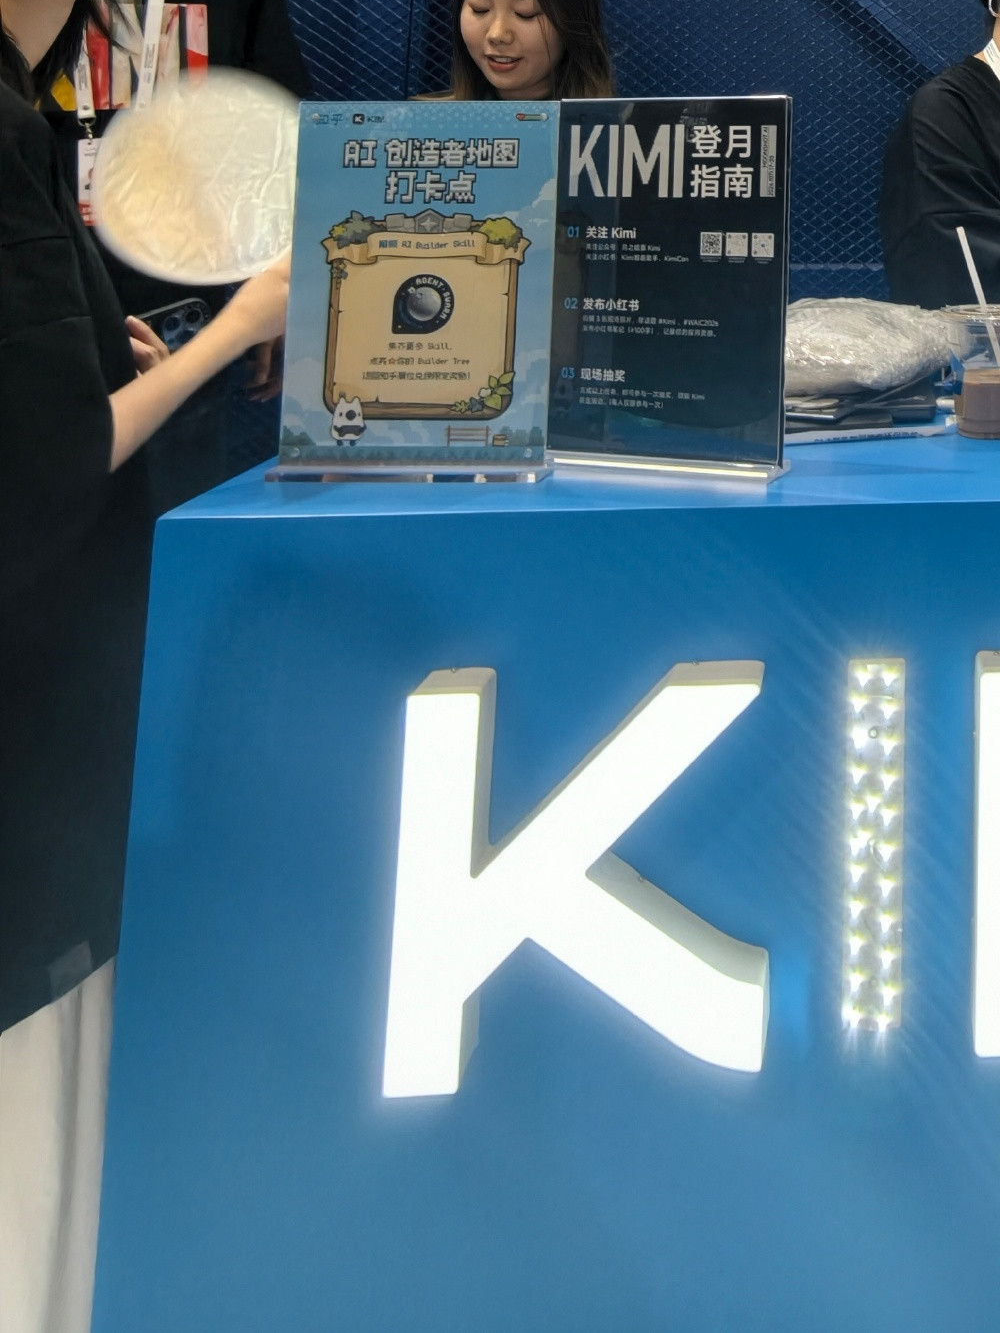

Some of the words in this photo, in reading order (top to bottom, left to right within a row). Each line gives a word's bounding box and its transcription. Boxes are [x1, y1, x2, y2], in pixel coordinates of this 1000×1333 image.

[691, 125, 752, 159] 登月
[343, 139, 378, 168] AI
[384, 138, 519, 168] 创造者地图
[568, 124, 685, 198] KIMI
[384, 171, 476, 204] 打卡点
[690, 164, 754, 199] 指南
[567, 226, 579, 238] 01
[586, 226, 609, 239] 关注
[611, 227, 637, 240] Kimi
[453, 239, 475, 249] Skill
[564, 297, 578, 310] 02
[583, 297, 640, 312] 发布小红书
[417, 357, 448, 366] Builder
[453, 357, 470, 366] Tree
[561, 367, 575, 379] 03
[580, 368, 626, 383] 现场抽奖
